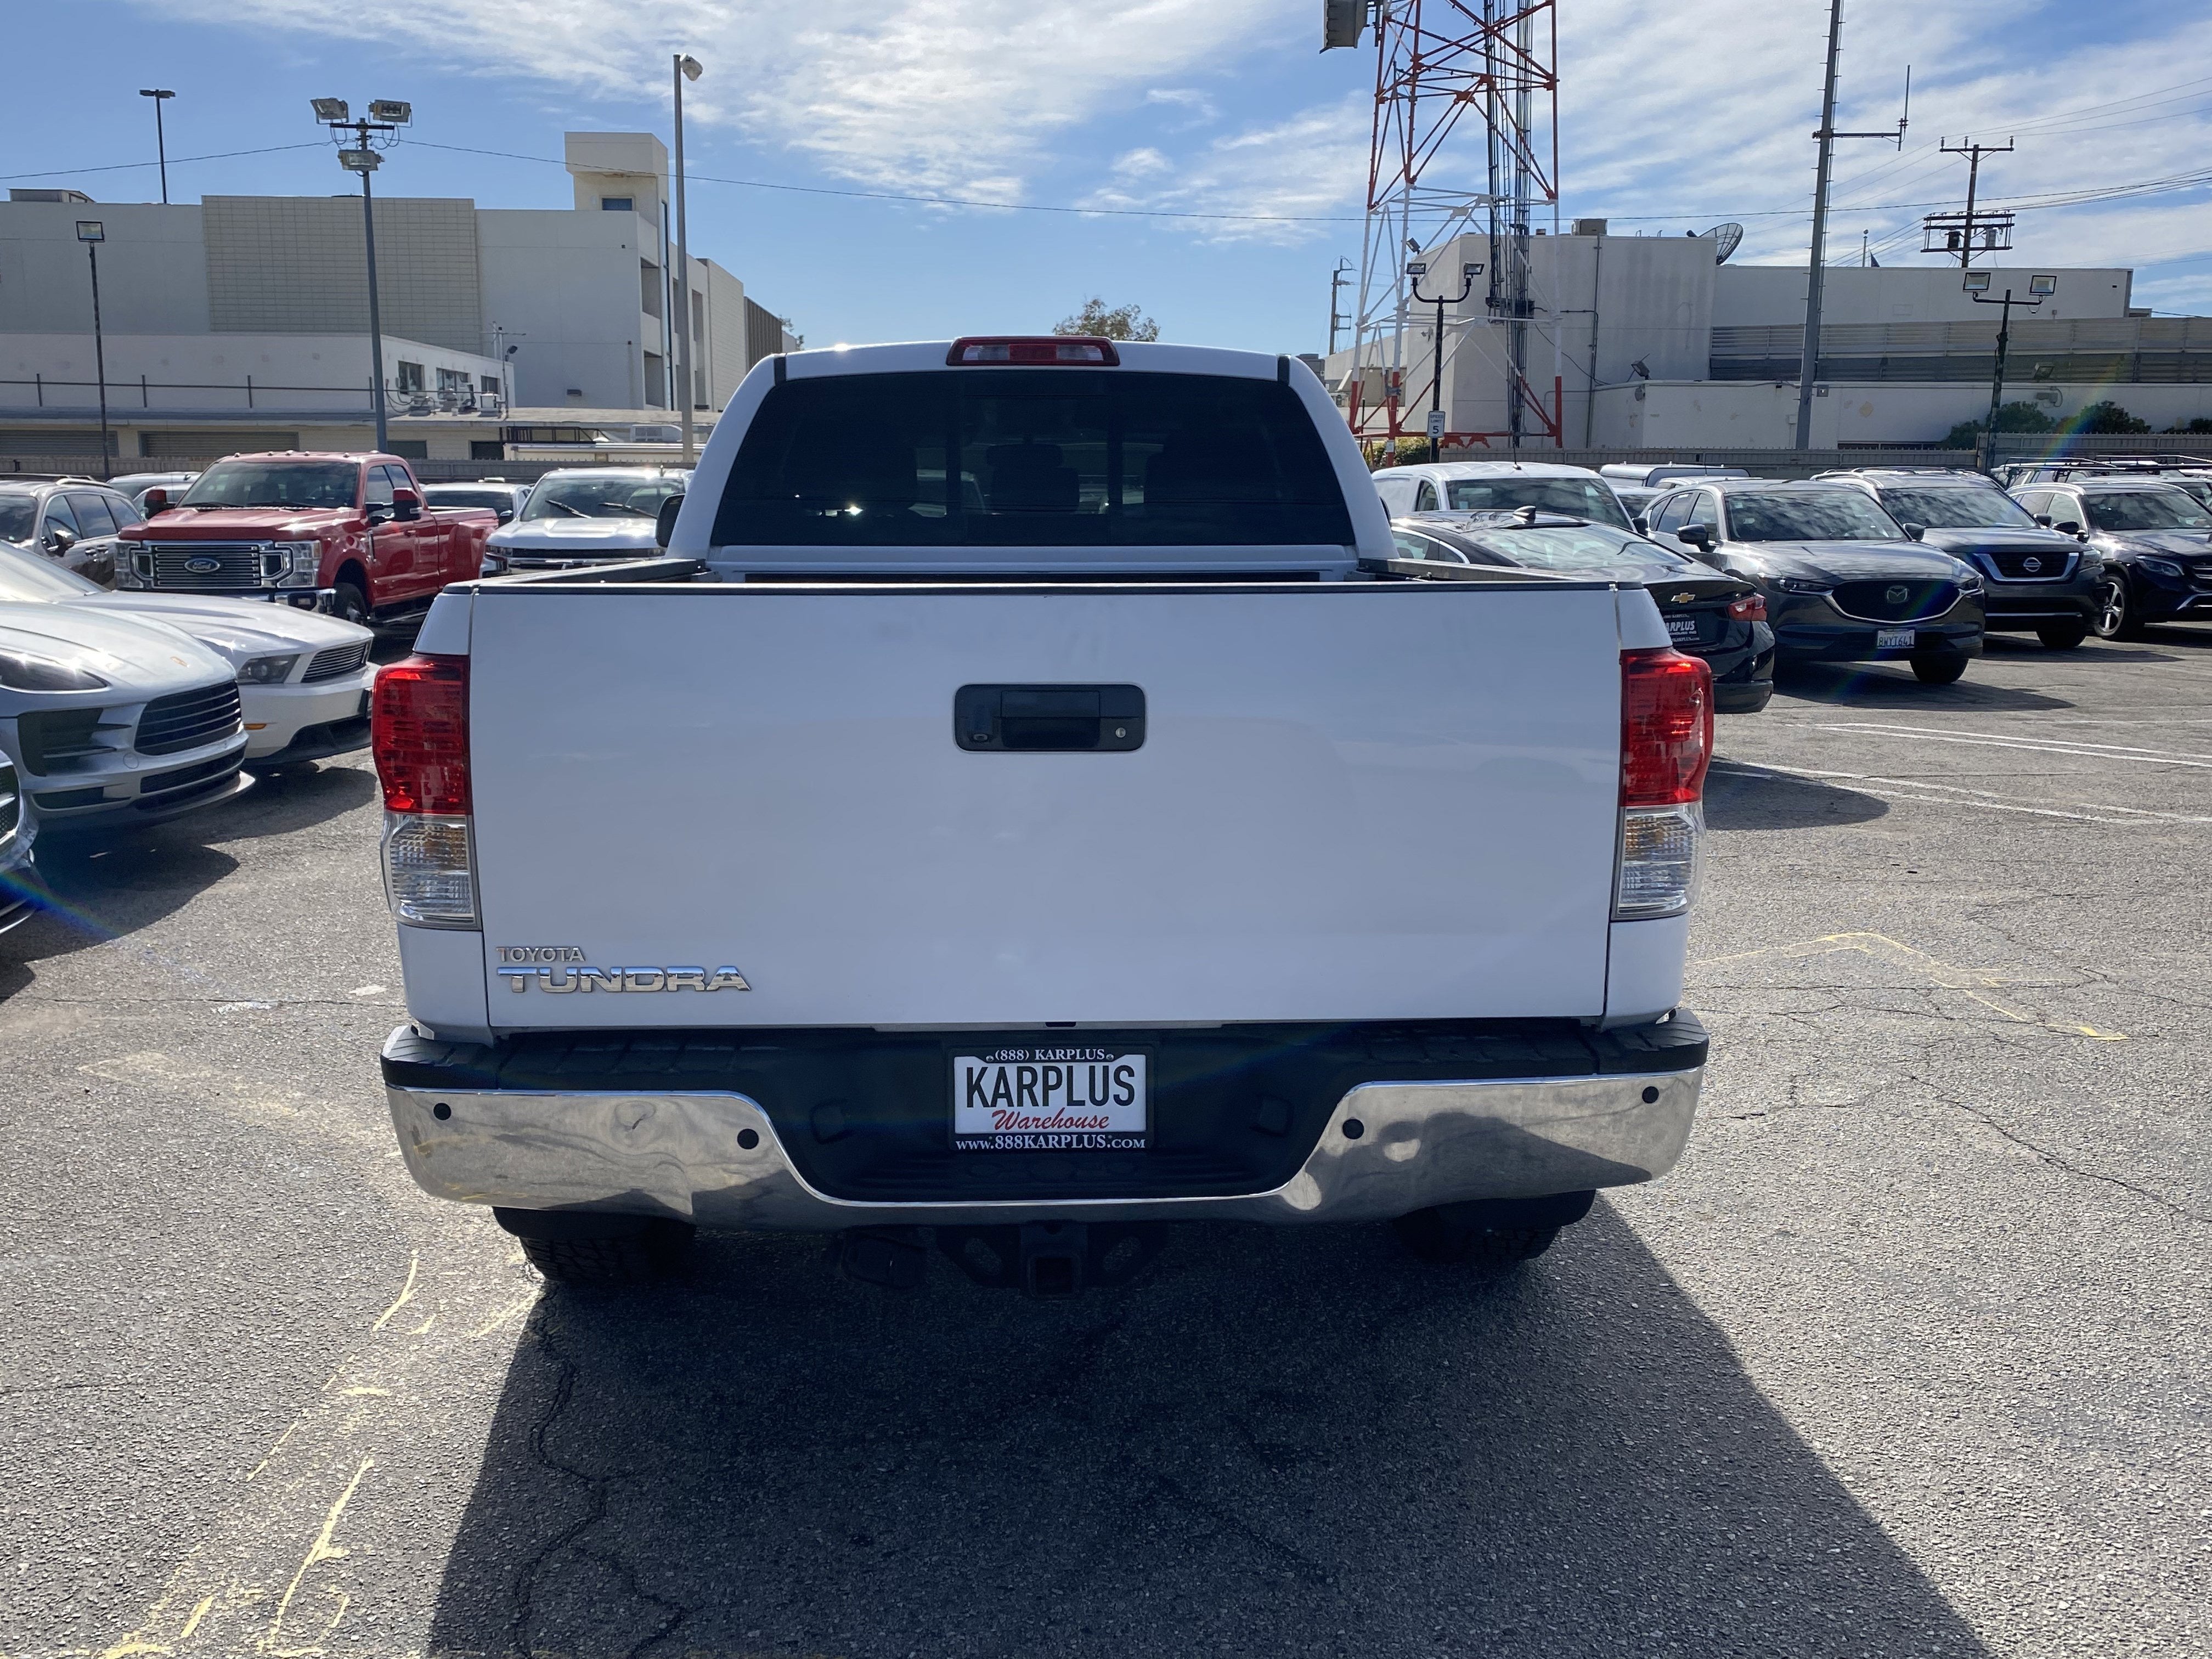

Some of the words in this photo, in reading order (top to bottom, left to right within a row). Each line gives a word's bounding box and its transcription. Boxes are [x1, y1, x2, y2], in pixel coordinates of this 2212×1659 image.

[1432, 425, 1440, 434] 5
[1666, 620, 1694, 631] ARPLUS
[496, 946, 586, 962] TOYOTA
[497, 966, 751, 993] TUNDRA
[995, 1049, 1030, 1061] (888)
[1034, 1048, 1105, 1060] KARPLUS
[966, 1065, 1136, 1108] KARPLUS
[991, 1107, 1110, 1130] Warehouse
